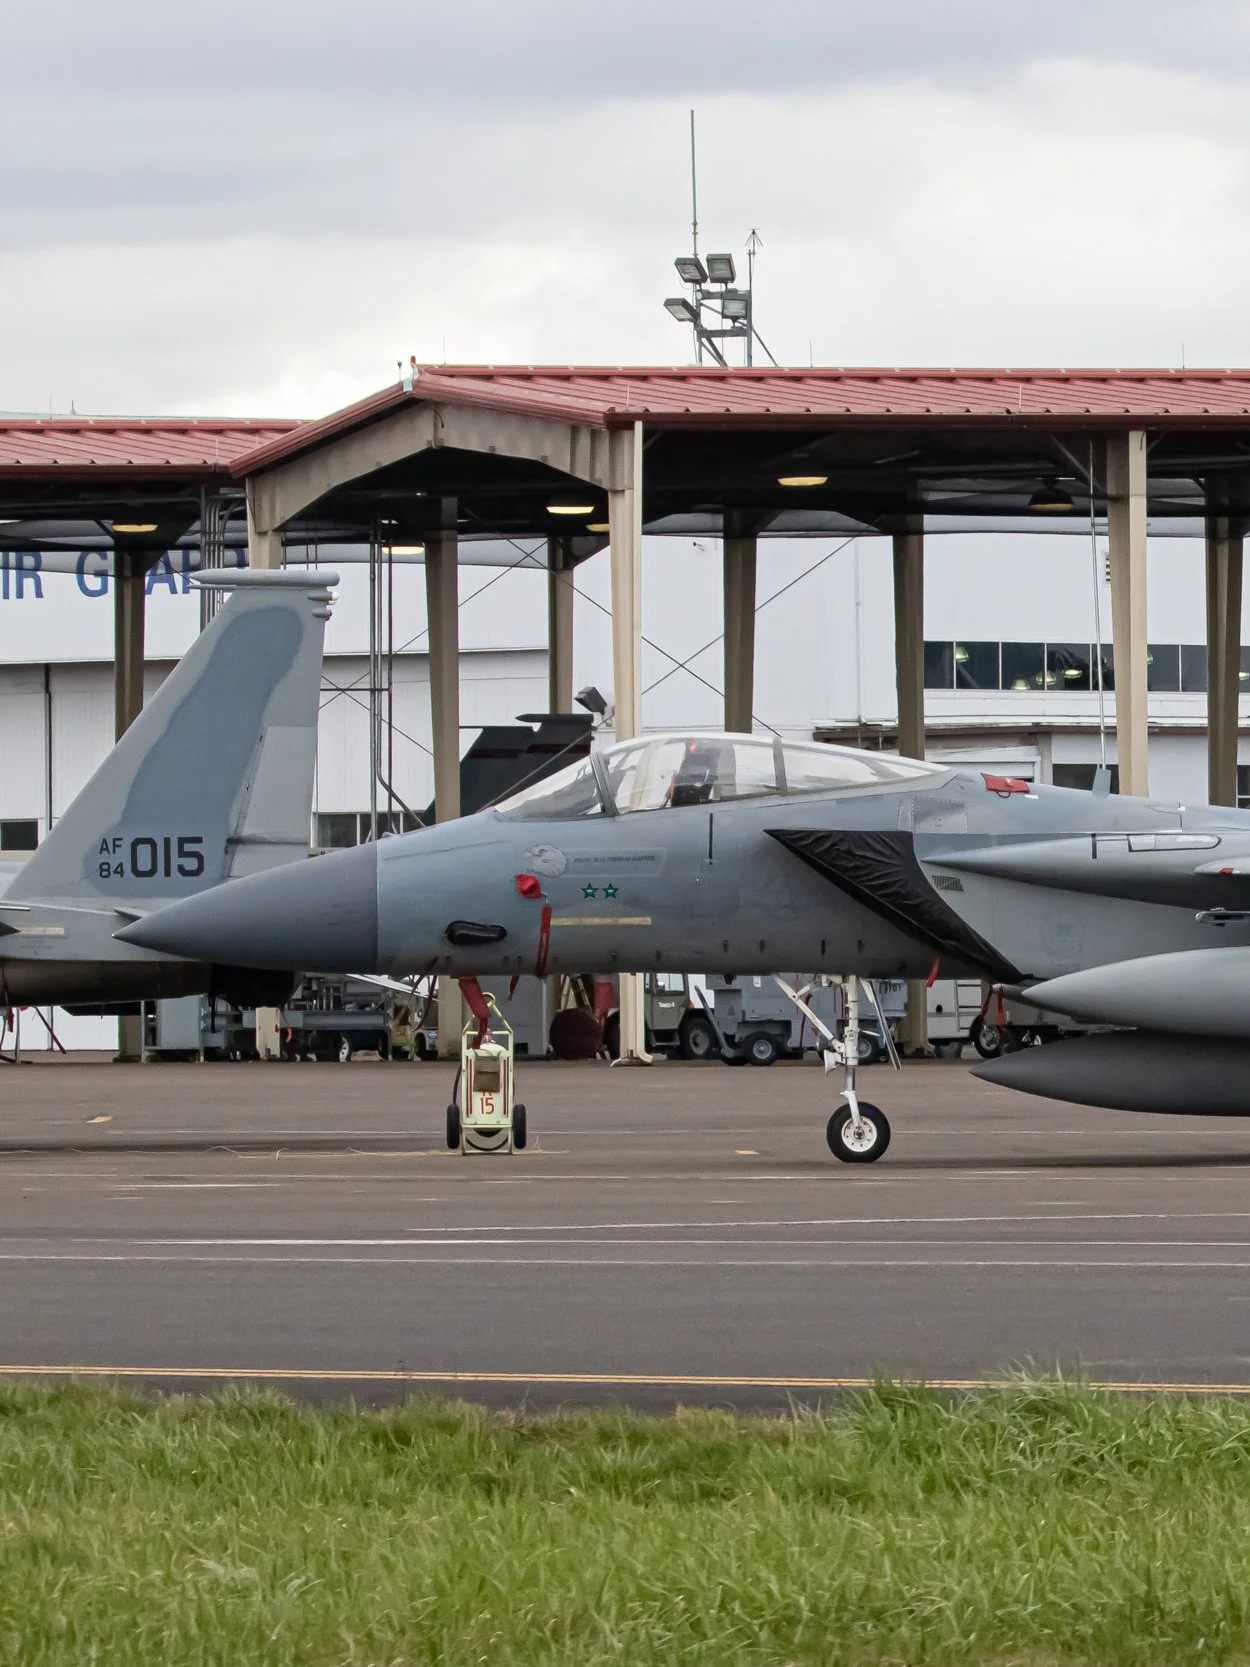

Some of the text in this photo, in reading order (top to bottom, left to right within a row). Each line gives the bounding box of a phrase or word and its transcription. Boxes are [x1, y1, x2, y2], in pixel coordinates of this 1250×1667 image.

[99, 838, 124, 855] AF
[130, 836, 205, 878] 015
[99, 861, 125, 878] 84
[480, 1097, 495, 1115] 15
